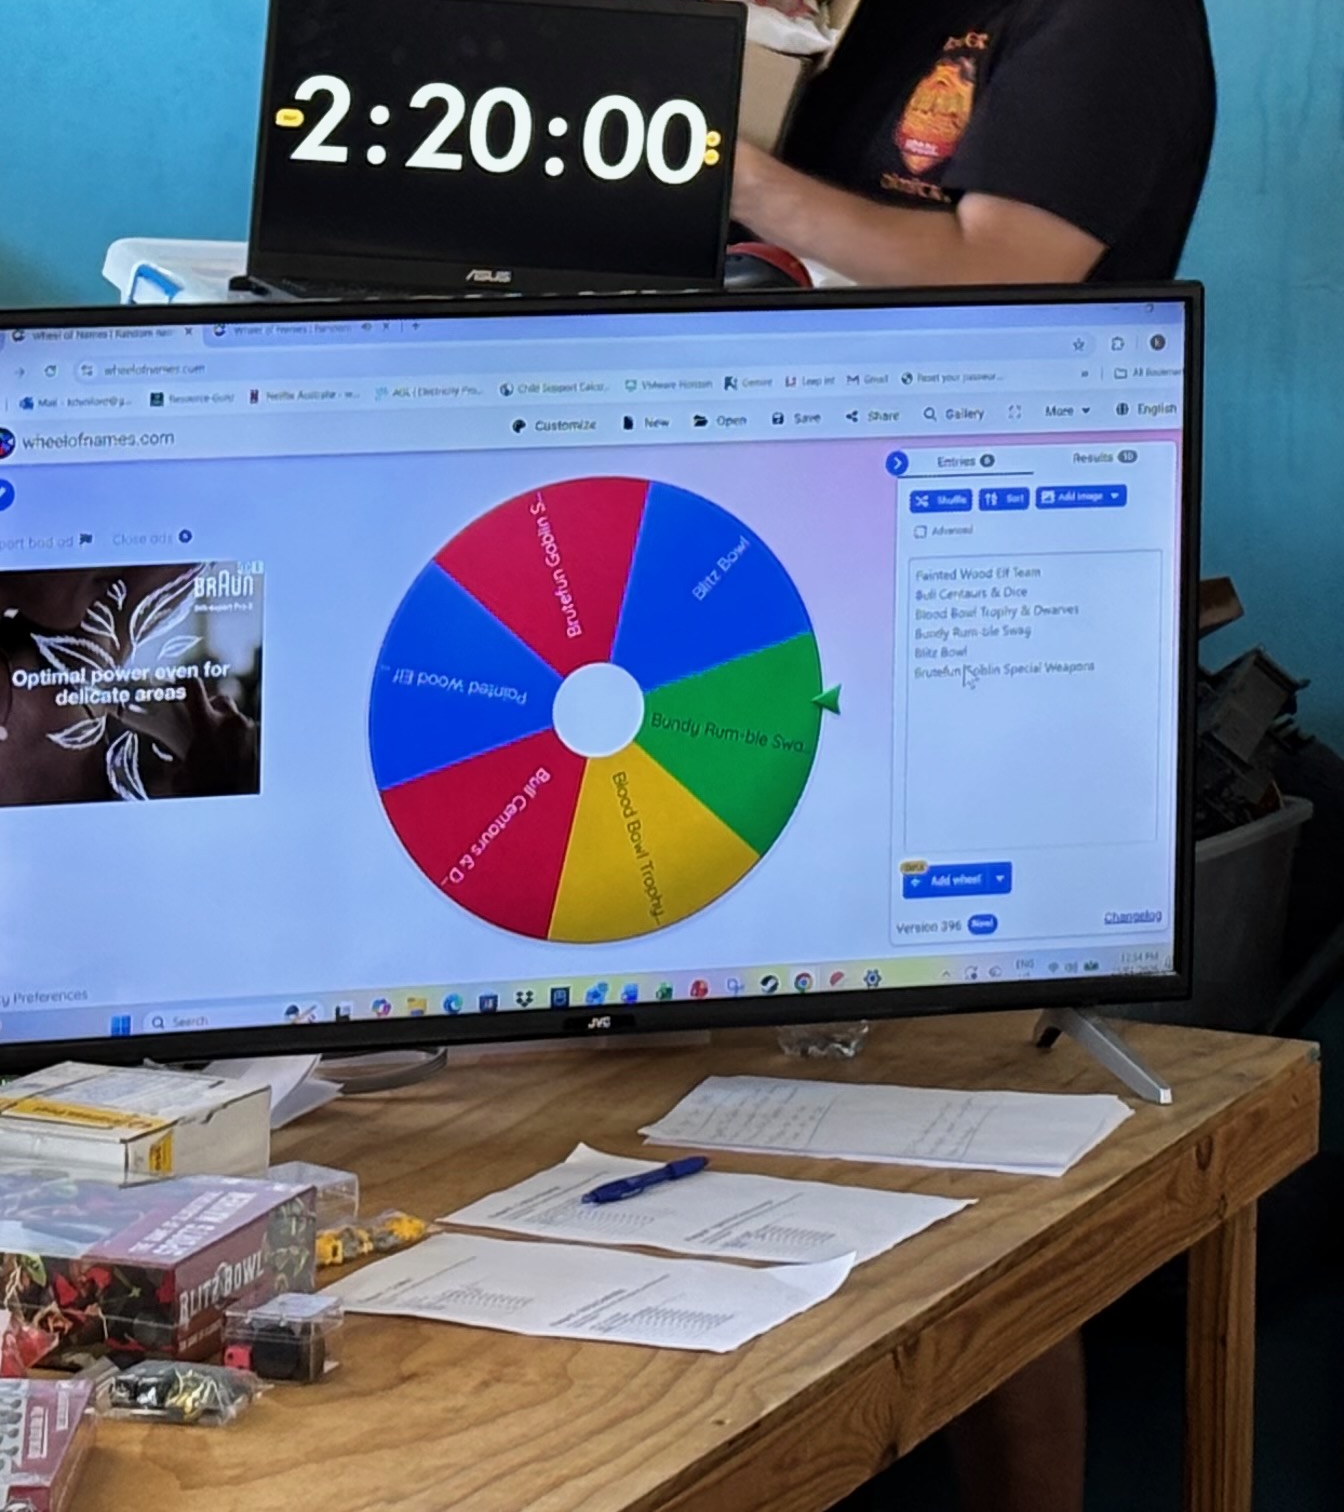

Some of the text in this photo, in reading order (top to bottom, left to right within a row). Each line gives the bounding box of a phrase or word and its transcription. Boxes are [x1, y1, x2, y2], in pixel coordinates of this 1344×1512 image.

[289, 74, 708, 185] 2:20:00
[466, 269, 512, 283] ASUS
[104, 363, 205, 375] wheelofnames.com
[867, 410, 901, 422] Share
[945, 407, 985, 421] Gallery
[1045, 406, 1074, 417] More
[1137, 403, 1178, 417] English
[534, 419, 597, 432] Customize
[644, 417, 670, 428] New
[716, 415, 748, 429] Open
[794, 413, 821, 425] Save
[22, 432, 175, 450] wheelofnames.com
[937, 456, 976, 468] Entries
[1073, 452, 1114, 464] Results
[112, 533, 146, 546] Close
[536, 516, 560, 568] Goblin
[692, 535, 751, 601] Blitz Bowl
[915, 567, 1041, 581] Painted Wood Elf Team
[194, 569, 254, 598] BRAUN
[938, 588, 987, 600] Centaurs
[1004, 586, 1028, 597] Dice
[553, 569, 582, 639] Brutefun
[915, 608, 948, 620] Blood
[951, 607, 977, 619] Bowl
[981, 606, 1017, 620] Trophy
[1034, 604, 1079, 615] Dwarves
[1002, 625, 1032, 639] Swag
[941, 646, 967, 658] Bowl
[12, 661, 231, 689] Optimal power even for
[1004, 662, 1042, 676] Special
[1044, 661, 1095, 676] Weapons
[393, 668, 527, 705] Painted Wood Elf
[55, 686, 187, 707] delicate areas
[651, 712, 700, 737] Bundy
[704, 721, 769, 746] Rum-ble
[524, 767, 552, 799] Bull
[612, 770, 638, 820] Blood
[626, 819, 649, 860] Bowl
[471, 794, 527, 857] Centaurs
[459, 853, 476, 870] &
[931, 873, 982, 886] Add wheel
[1104, 909, 1162, 924] Changelog
[896, 921, 938, 934] Version
[13, 989, 88, 1005] Preferences
[172, 1016, 208, 1028] Search
[587, 1015, 612, 1029] JVC
[179, 1251, 264, 1331] BLITZ BOWL
